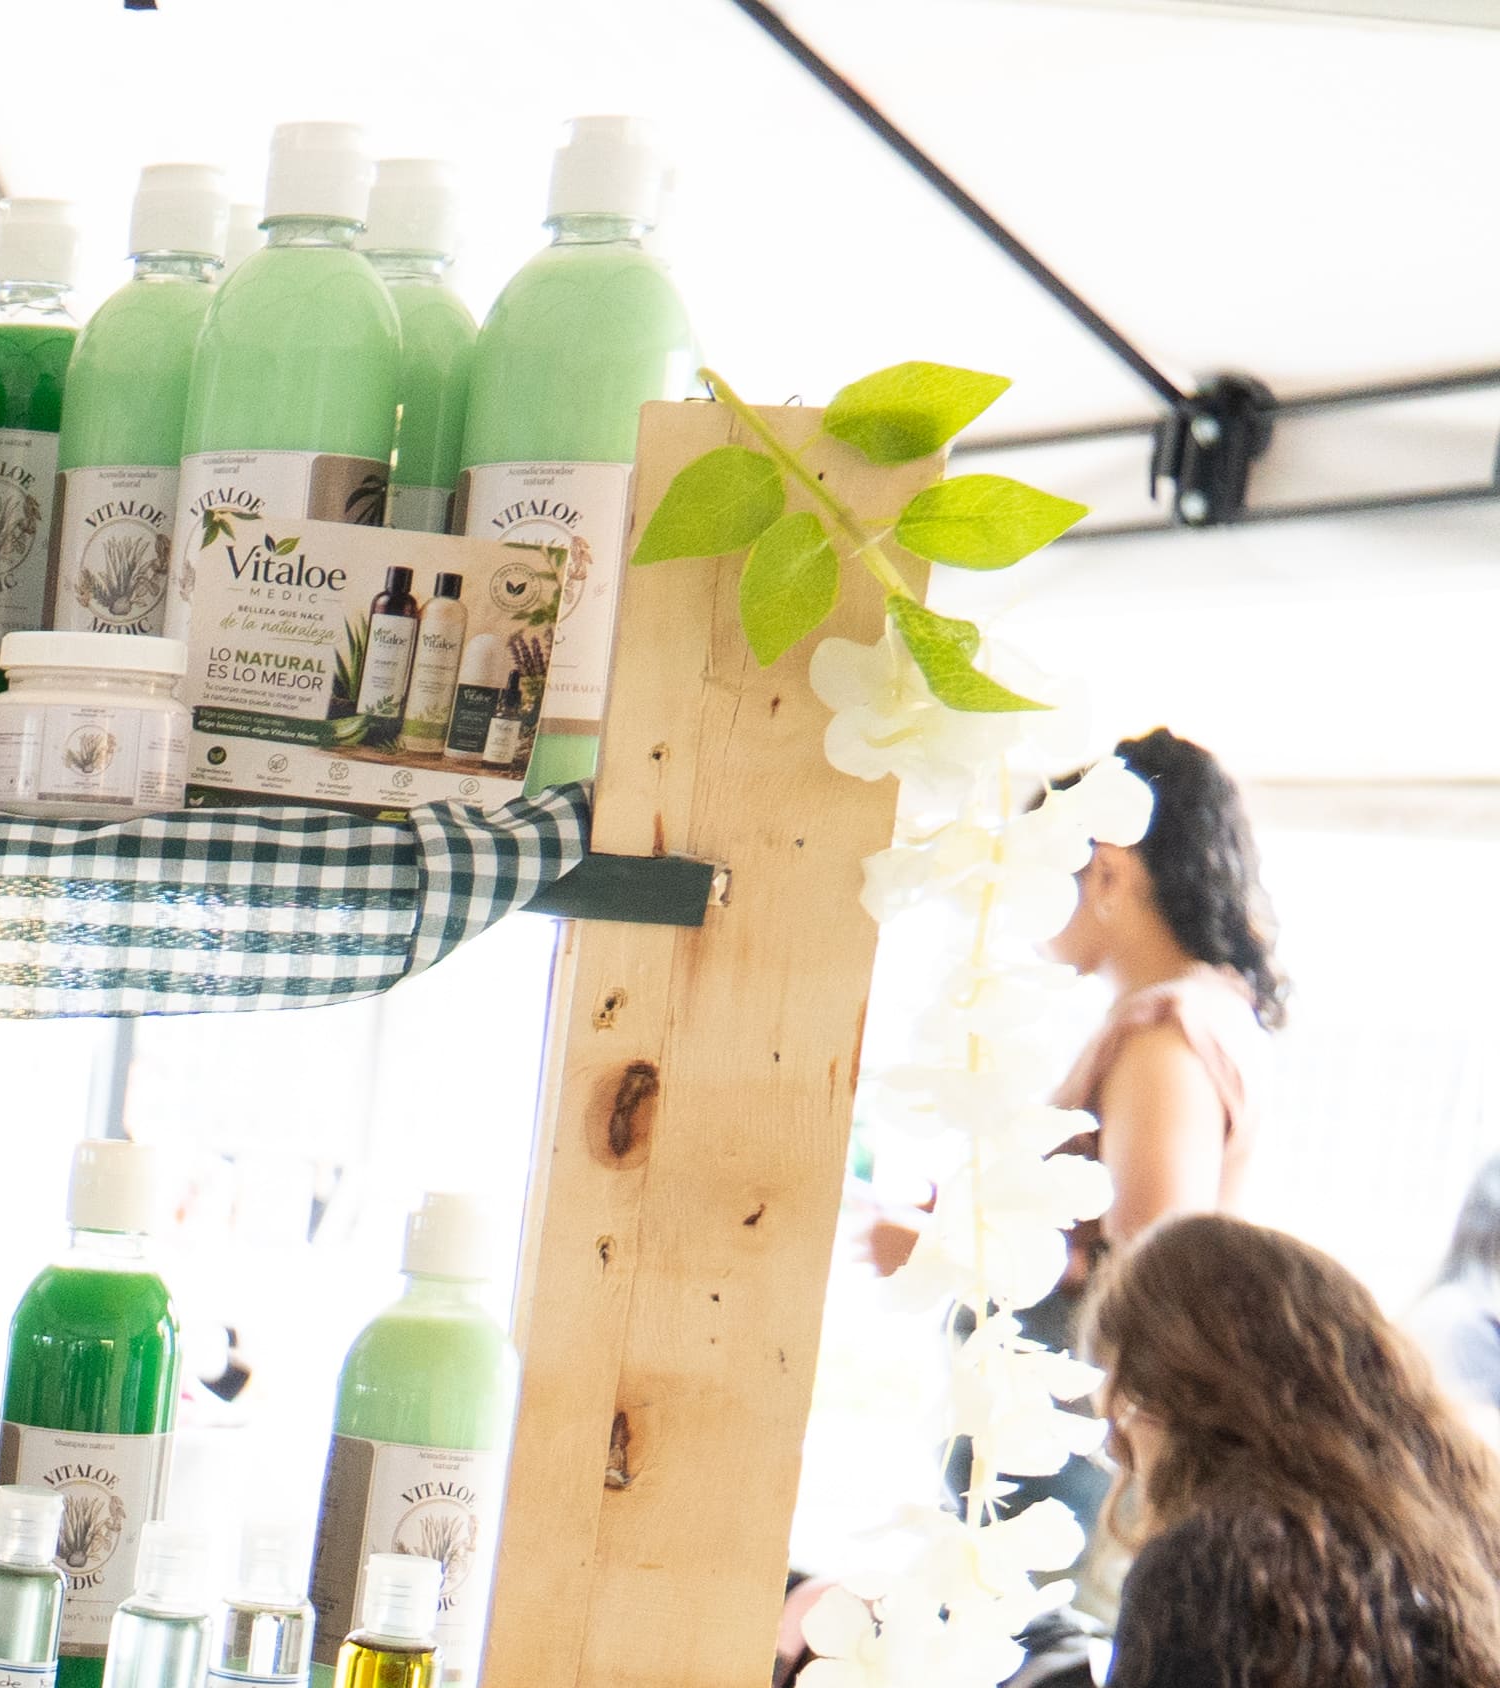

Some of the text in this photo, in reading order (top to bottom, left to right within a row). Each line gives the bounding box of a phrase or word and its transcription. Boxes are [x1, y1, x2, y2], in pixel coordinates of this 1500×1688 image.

[84, 500, 167, 529] VITALOE
[188, 486, 267, 518] VITALOE
[490, 499, 584, 531] VITALOE
[225, 544, 347, 592] Vitaloe
[249, 587, 318, 605] MEDIC
[89, 615, 154, 635] MEDIC
[209, 646, 327, 674] LO NATURAL
[206, 664, 324, 692] ES LO MEJOR
[43, 1463, 121, 1491] VITALOE
[401, 1481, 478, 1509] VITALOE
